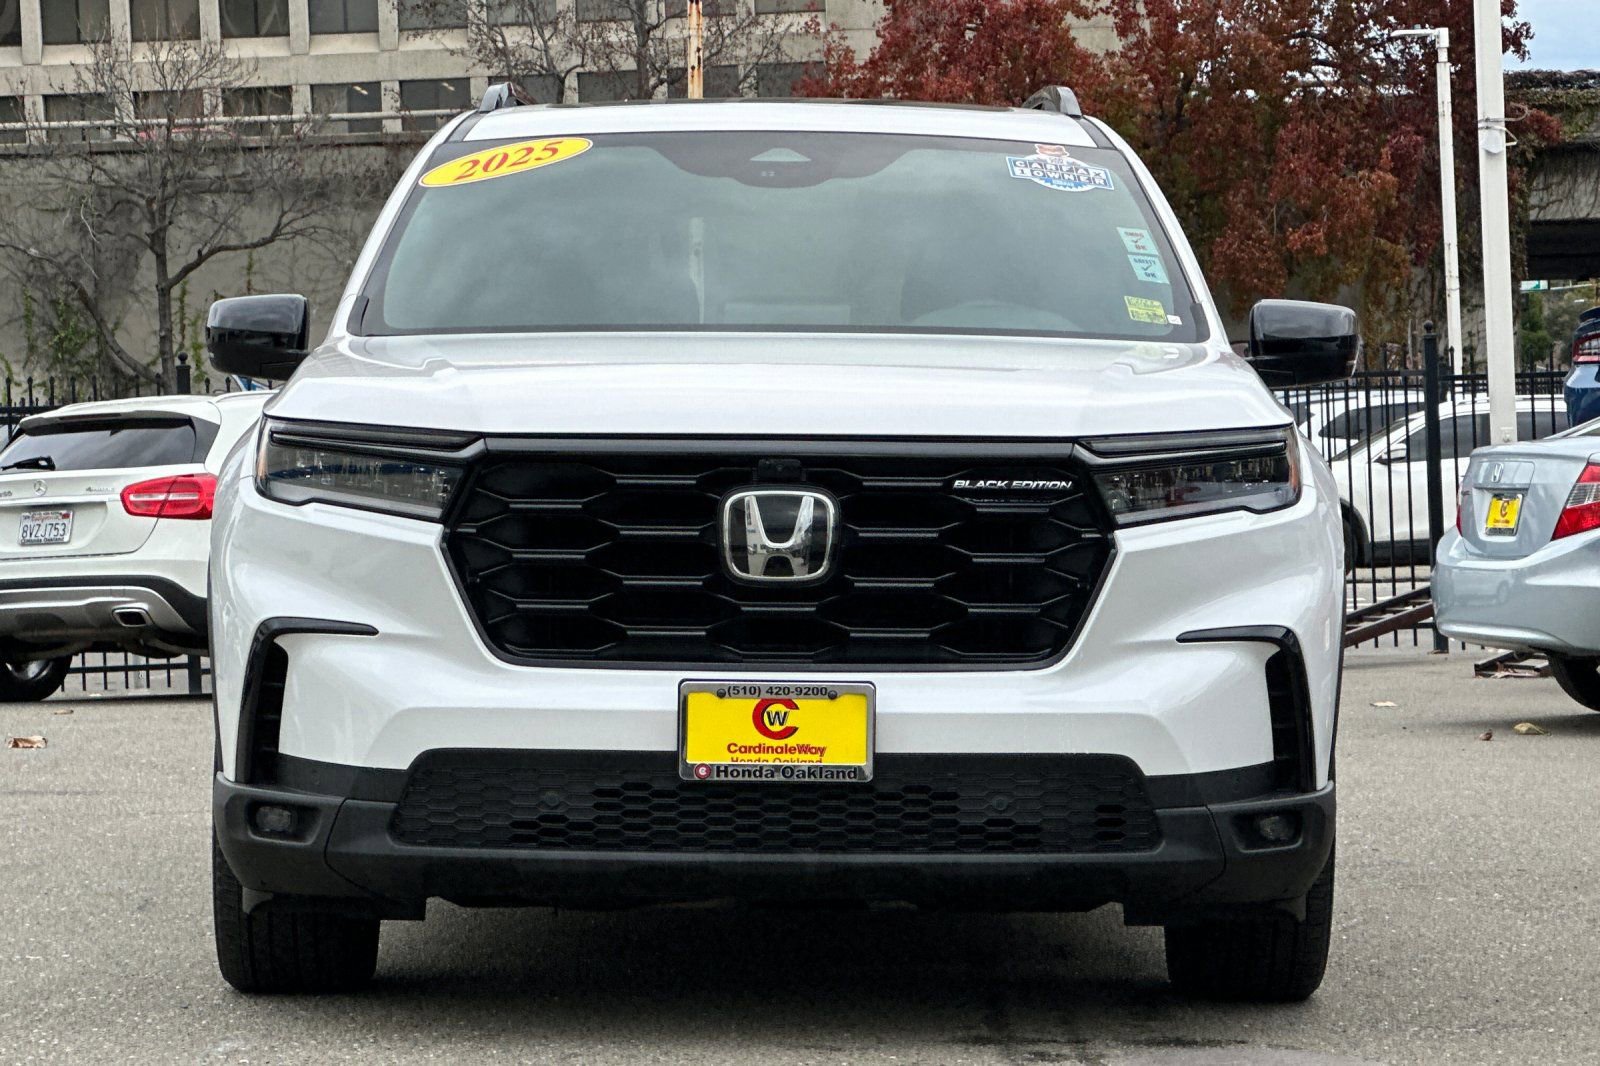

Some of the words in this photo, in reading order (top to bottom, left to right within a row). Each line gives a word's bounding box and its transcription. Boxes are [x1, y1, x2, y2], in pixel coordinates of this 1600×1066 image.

[453, 141, 564, 181] 2025
[1015, 160, 1104, 178] CARFAX
[1032, 170, 1105, 185] OWNER
[953, 480, 1008, 489] BLACK
[1010, 480, 1073, 489] EDITION
[21, 522, 67, 539] 8VZJ753
[727, 685, 761, 698] (510)
[765, 686, 828, 697] 420-9200
[727, 742, 827, 758] CardinaleWay
[715, 765, 775, 779] Honda
[781, 765, 858, 779] Oakland
